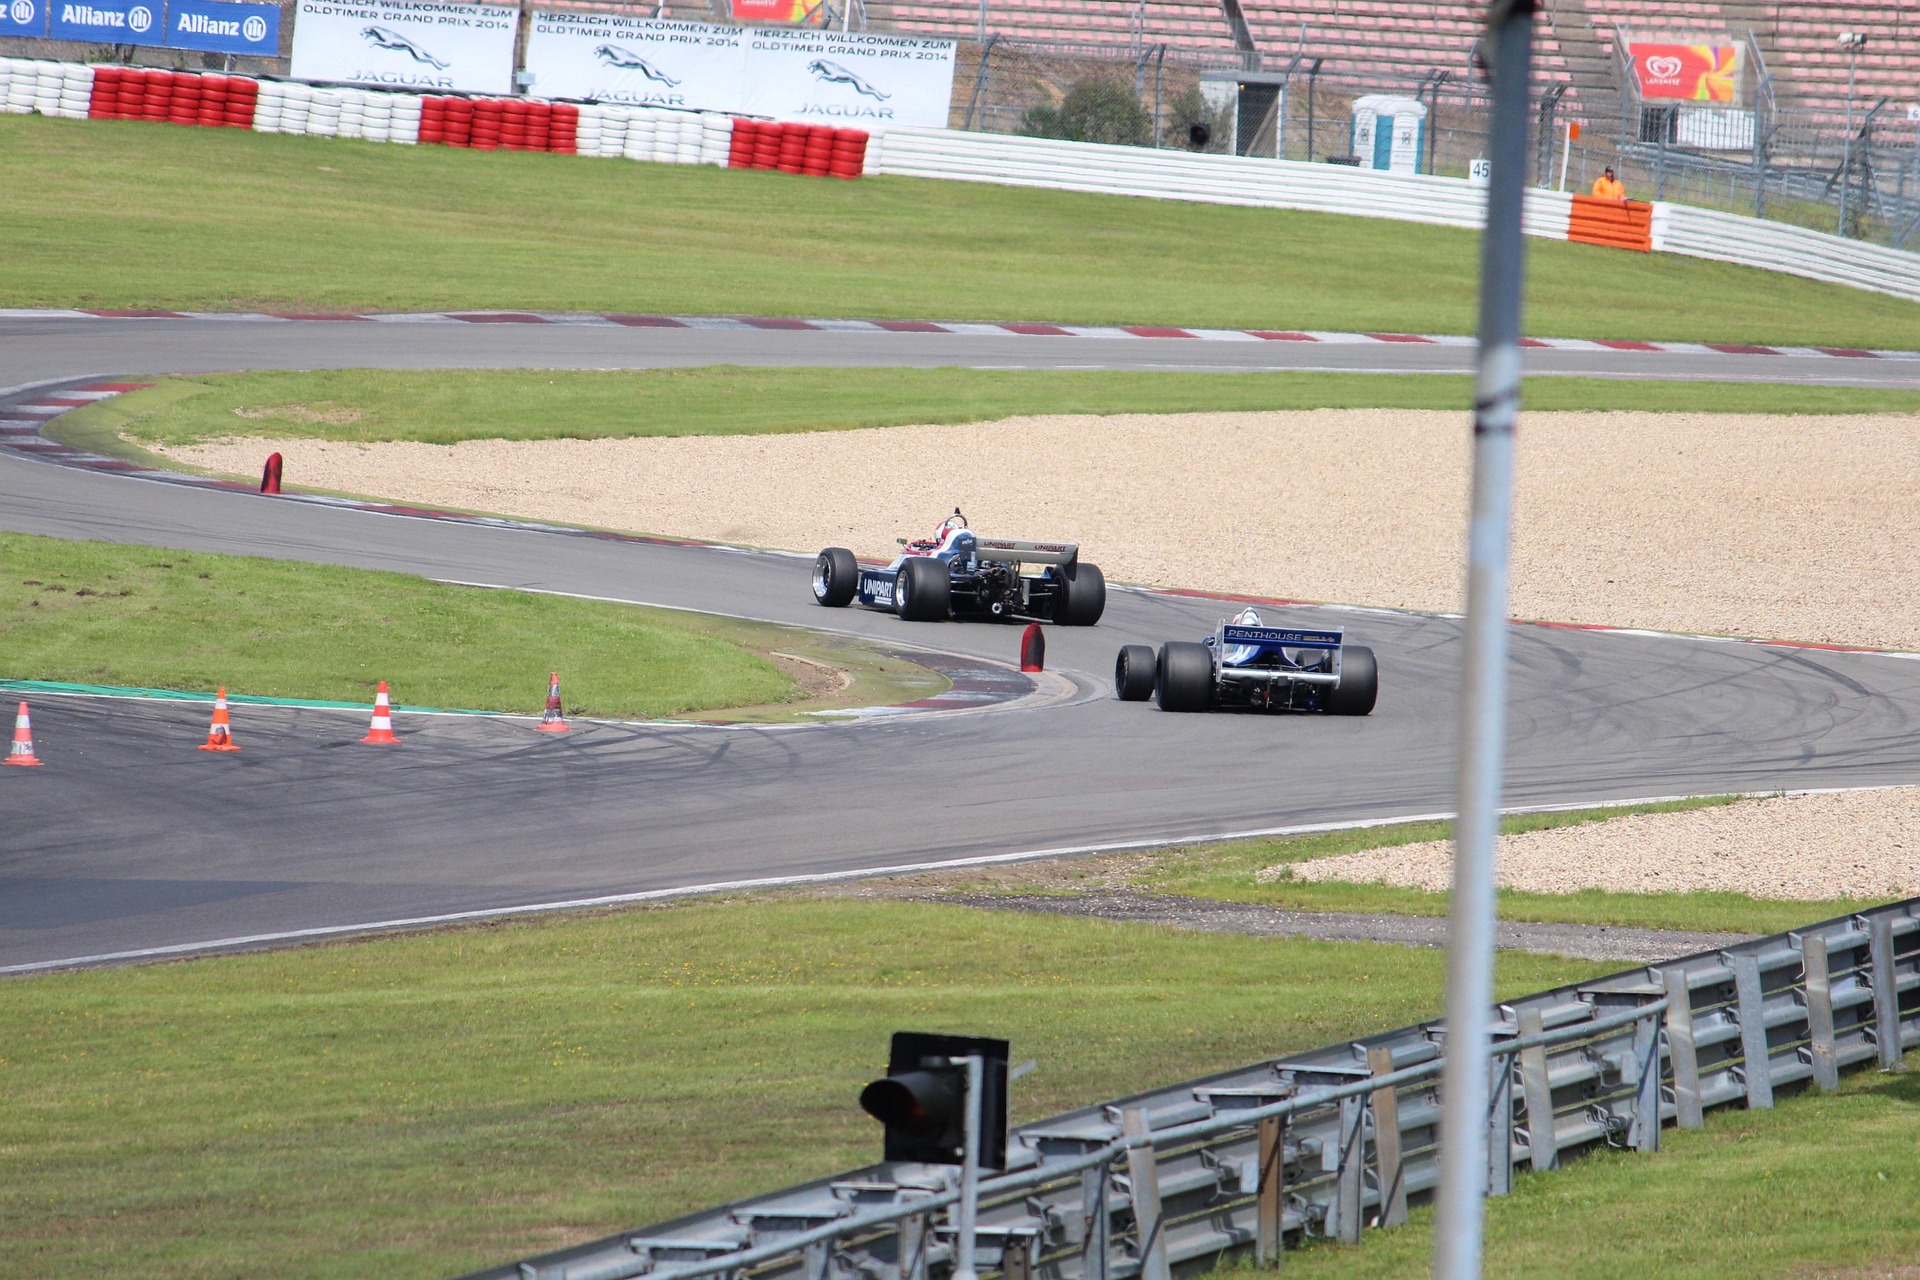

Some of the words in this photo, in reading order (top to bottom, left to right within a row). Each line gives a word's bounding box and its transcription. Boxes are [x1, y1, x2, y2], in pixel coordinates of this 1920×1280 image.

[61, 5, 125, 27] Allianz
[303, 5, 378, 19] OLDTIMER
[383, 12, 433, 24] GRAND
[438, 17, 471, 28] PRIX
[475, 20, 509, 30] 2014
[378, 1, 478, 15] WILLKOMMEN
[481, 9, 513, 18] ZUM
[177, 13, 240, 36] Allianz
[538, 13, 608, 25] HERZLICH
[613, 18, 708, 34] WILLKOMMEN
[713, 26, 743, 36] ZUM
[537, 25, 611, 38] OLDTIMER
[616, 30, 665, 42] GRAND
[669, 34, 701, 45] PRIX
[706, 37, 739, 48] 2014
[753, 29, 821, 41] HERZLICH
[825, 34, 918, 48] WILLKOMMEN
[922, 40, 951, 50] ZUM
[752, 40, 824, 54] OLDTIMER
[828, 45, 876, 57] GRAND
[880, 49, 911, 60] PRIX
[915, 51, 948, 61] 2014
[346, 69, 454, 88] JAGUAR
[579, 87, 685, 105] JAGUAR
[794, 101, 894, 119] JAGUAR
[1473, 162, 1490, 178] 45
[983, 541, 1016, 550] UNIPART
[1034, 544, 1067, 553] UNIPART
[864, 578, 893, 598] UNIPART
[1228, 629, 1302, 641] PENTHOUSE
